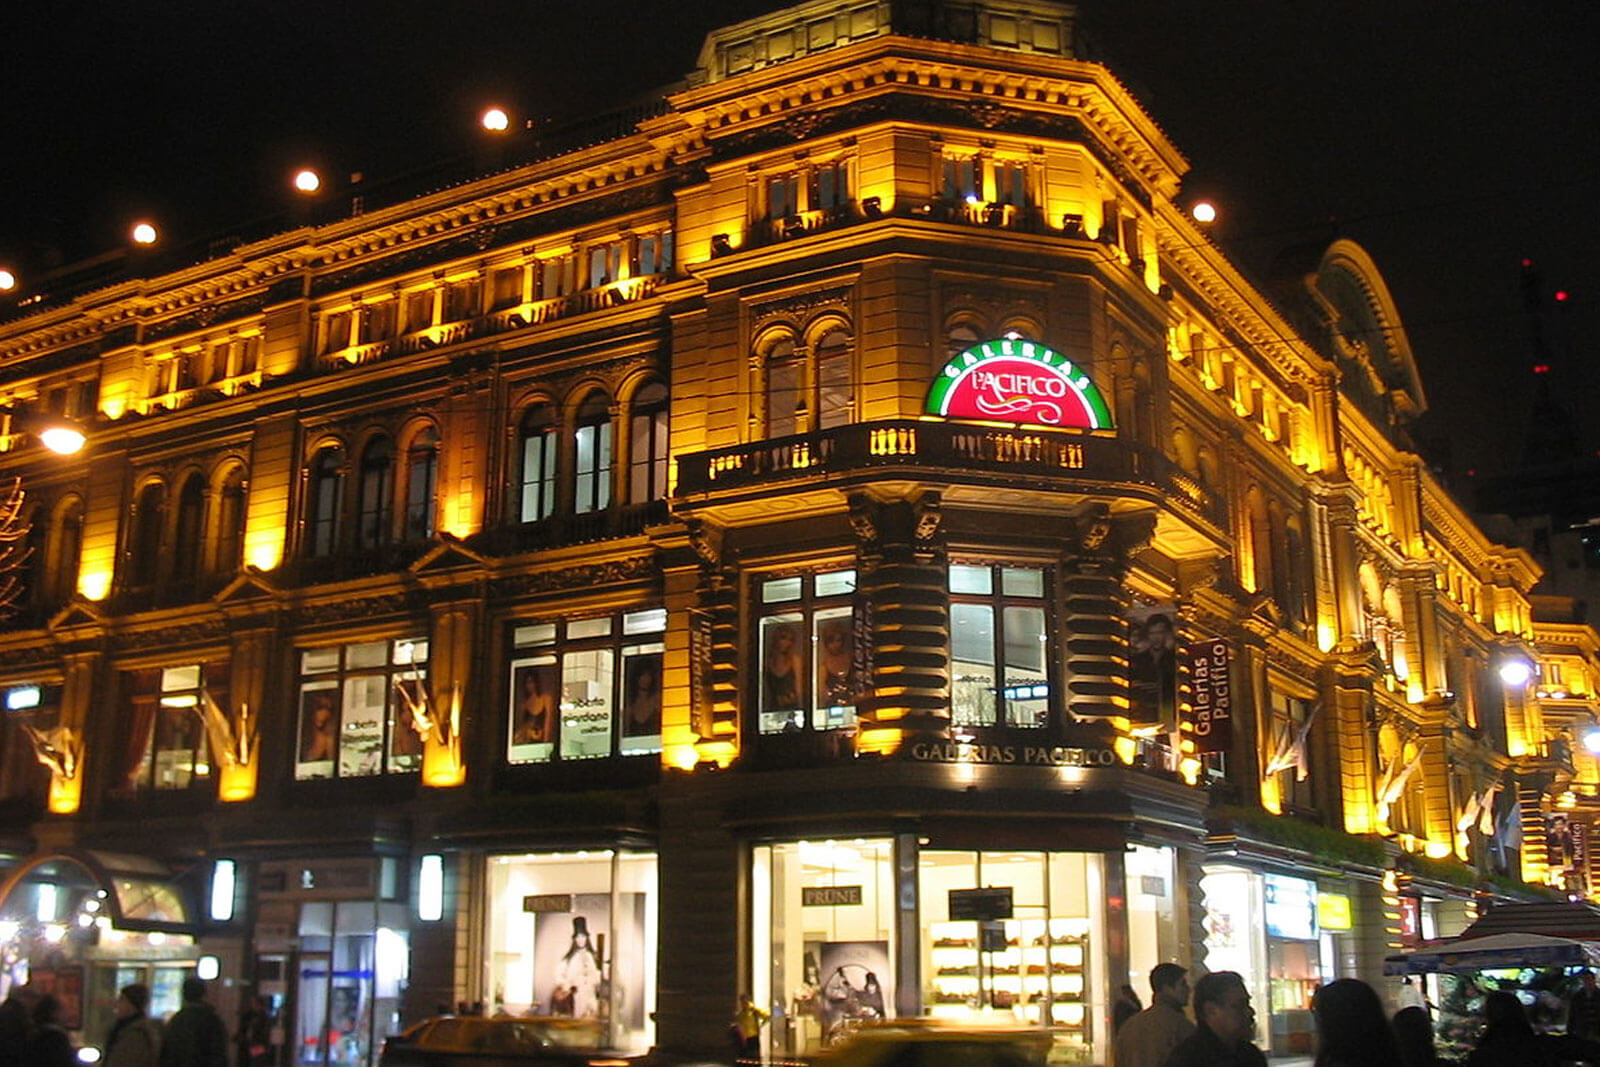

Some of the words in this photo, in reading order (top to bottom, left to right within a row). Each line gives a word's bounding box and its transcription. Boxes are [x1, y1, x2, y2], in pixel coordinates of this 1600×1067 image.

[943, 340, 1091, 390] GALERIAS
[971, 370, 1067, 400] PACIFICO
[912, 742, 1016, 763] GALRIAS
[806, 888, 860, 905] PRUNE
